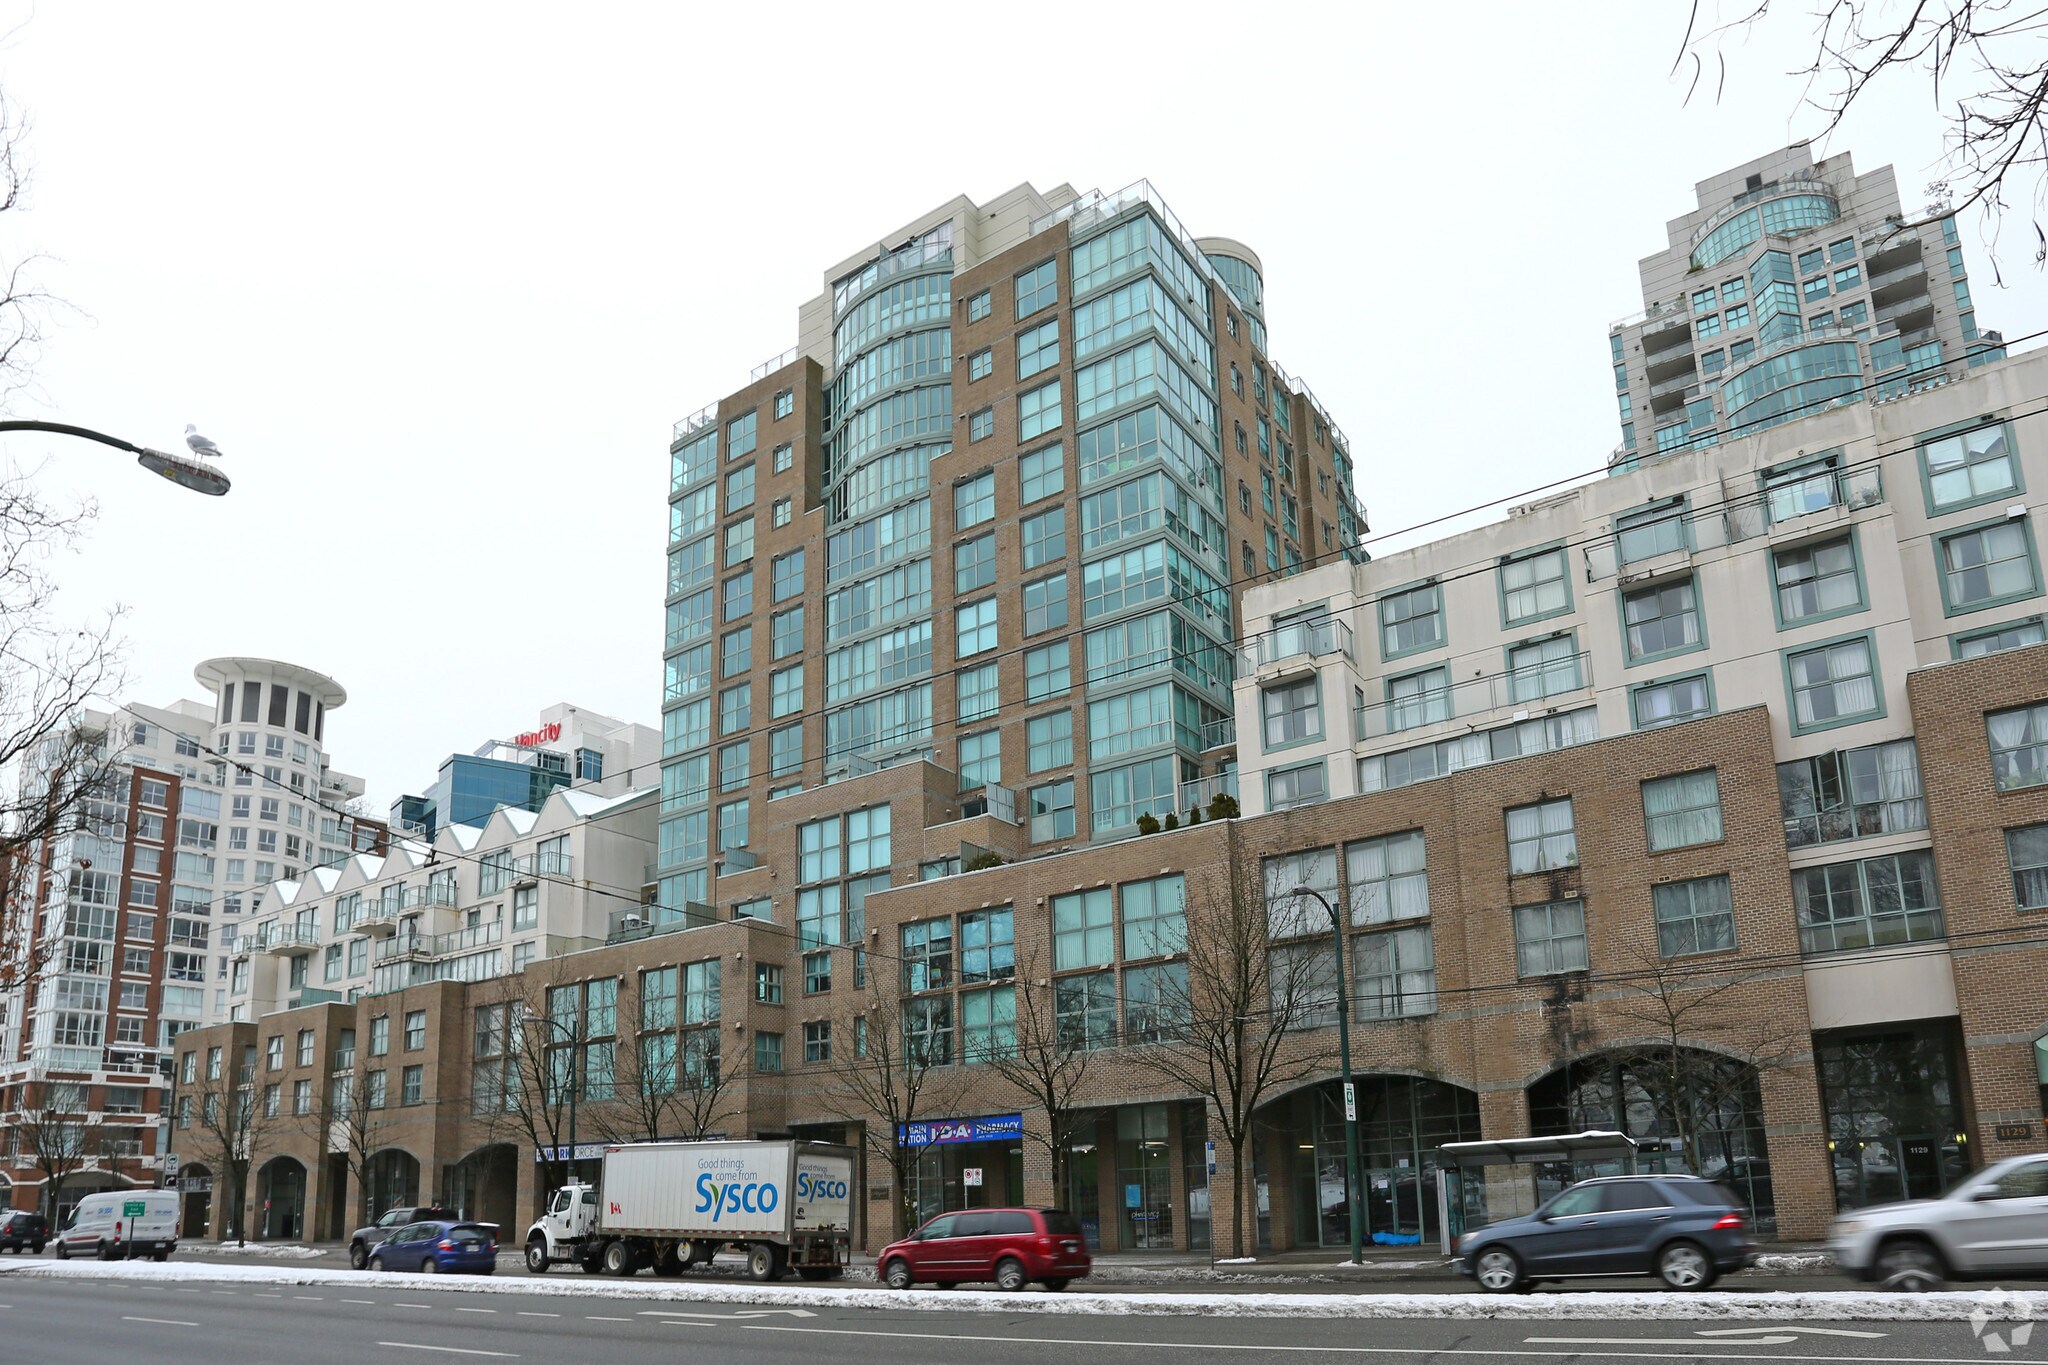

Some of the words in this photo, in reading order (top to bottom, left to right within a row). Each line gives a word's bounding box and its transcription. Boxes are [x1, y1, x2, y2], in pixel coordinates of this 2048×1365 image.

[515, 722, 561, 747] Vancity
[976, 1121, 1019, 1134] PHARMACY
[2000, 1128, 2027, 1136] 1129
[546, 1146, 594, 1160] WRKORCE
[1910, 1146, 1929, 1154] 1129
[698, 1158, 718, 1169] Good
[720, 1158, 744, 1171] things
[813, 1164, 828, 1173] things
[715, 1173, 737, 1181] come
[738, 1170, 758, 1181] from
[823, 1172, 836, 1180] from
[798, 1172, 847, 1203] Sysco
[695, 1173, 778, 1222] Sysco
